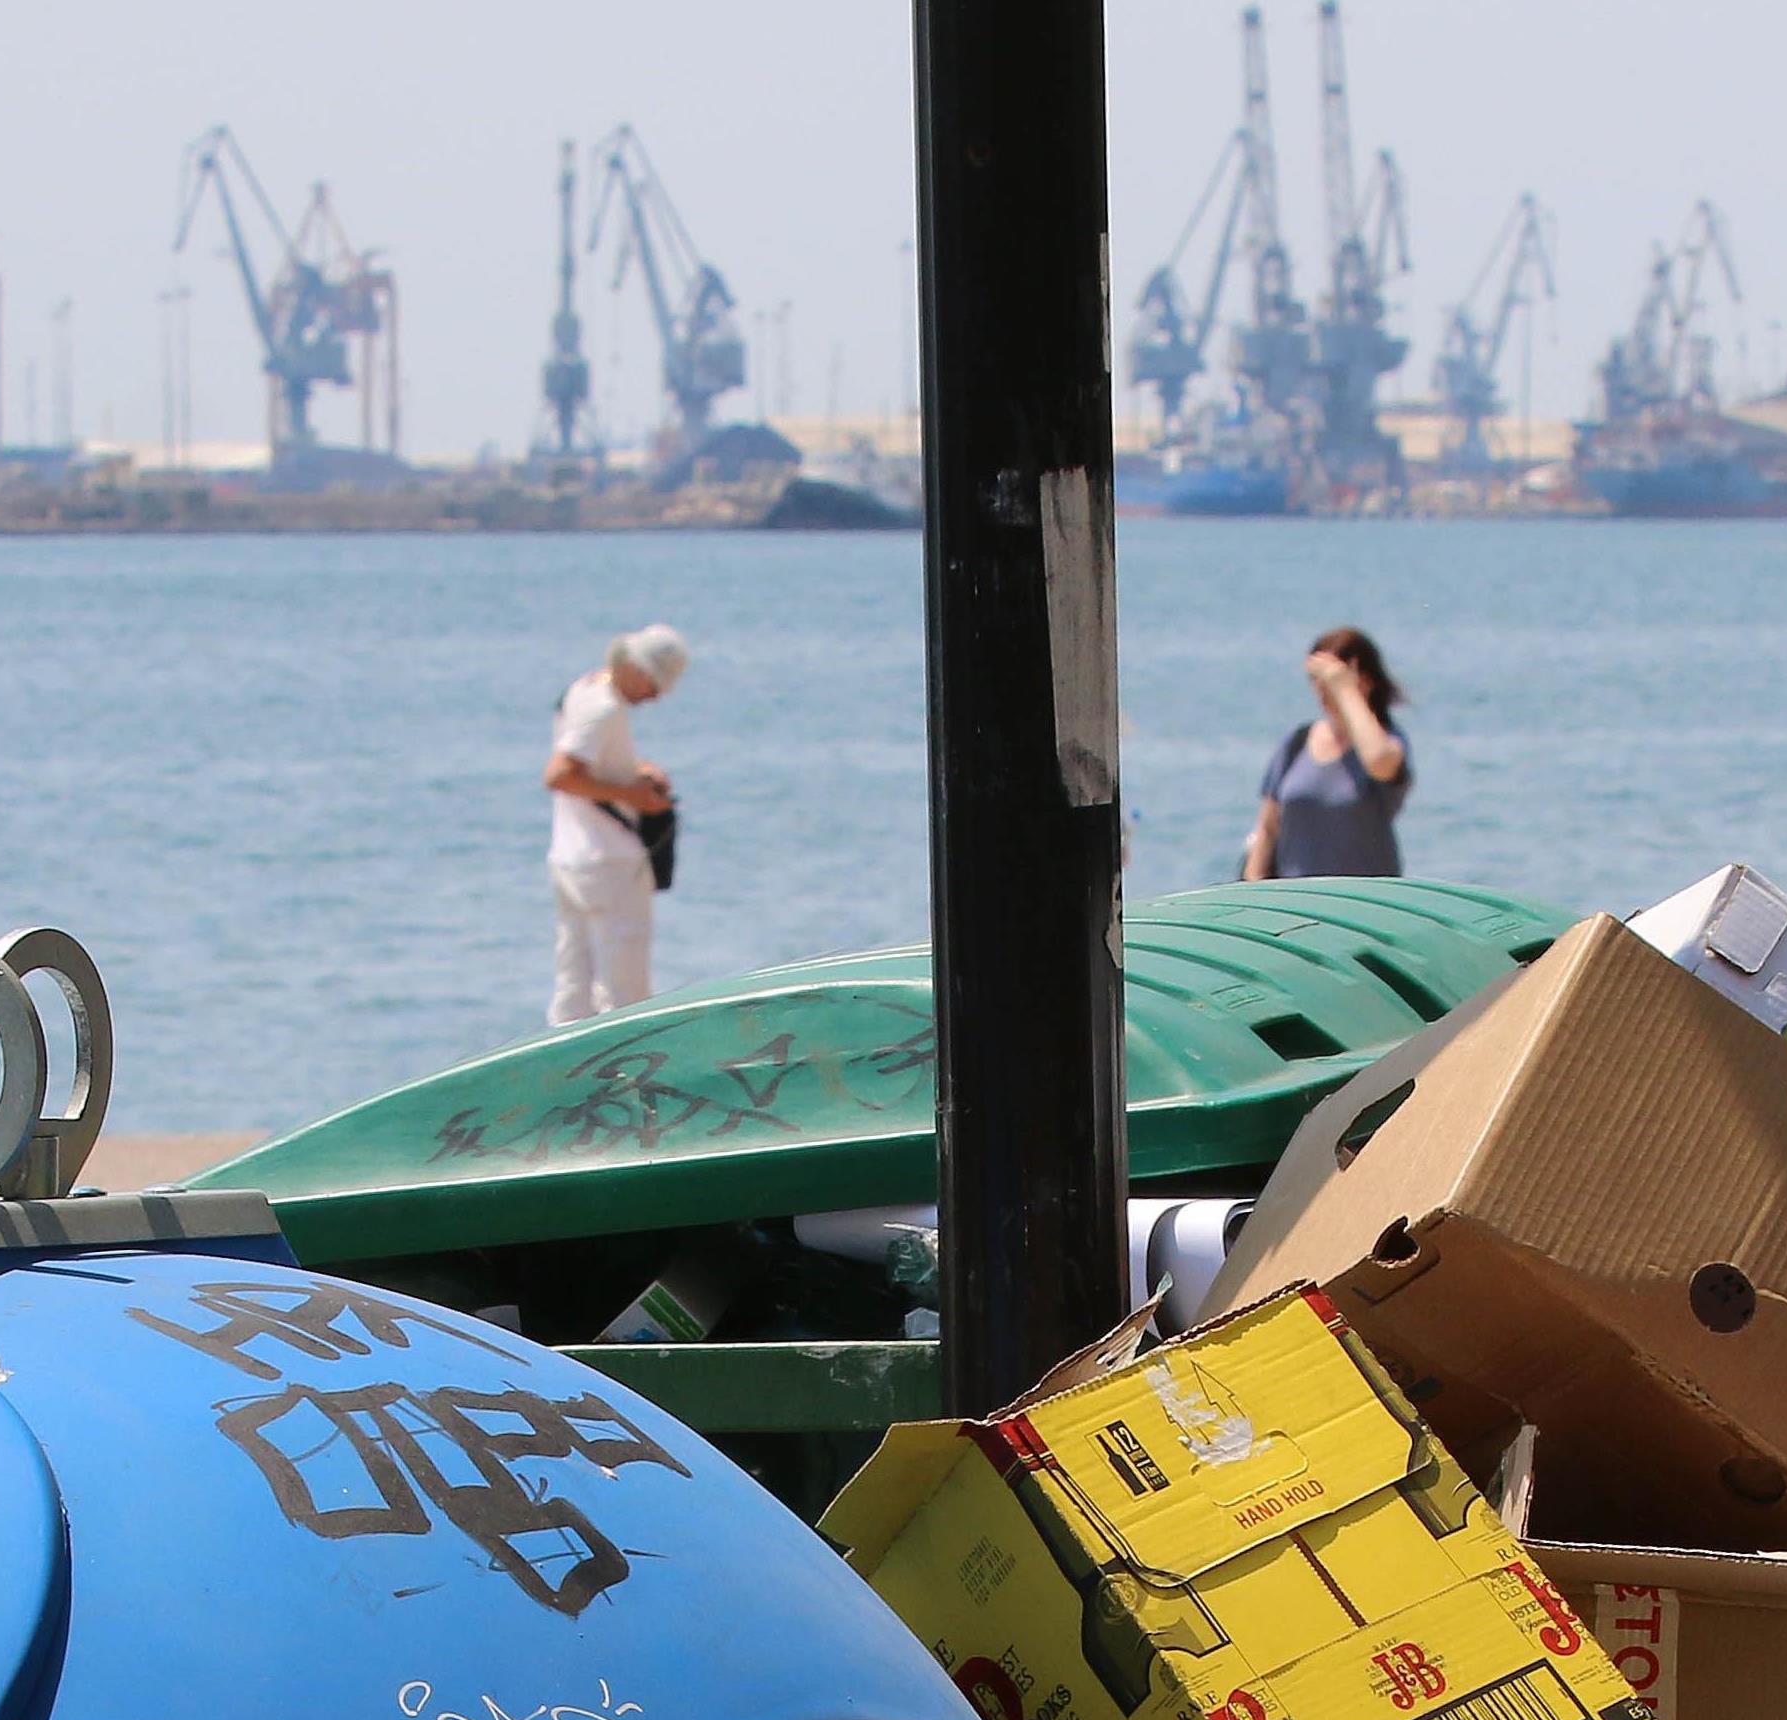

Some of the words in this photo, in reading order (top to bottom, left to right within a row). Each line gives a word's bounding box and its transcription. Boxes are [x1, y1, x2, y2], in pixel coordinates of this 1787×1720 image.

[1112, 1426, 1139, 1455] 12
[1233, 1495, 1285, 1531] HAND
[1283, 1479, 1325, 1509] HOLD
[1371, 1642, 1448, 1711] J&B
